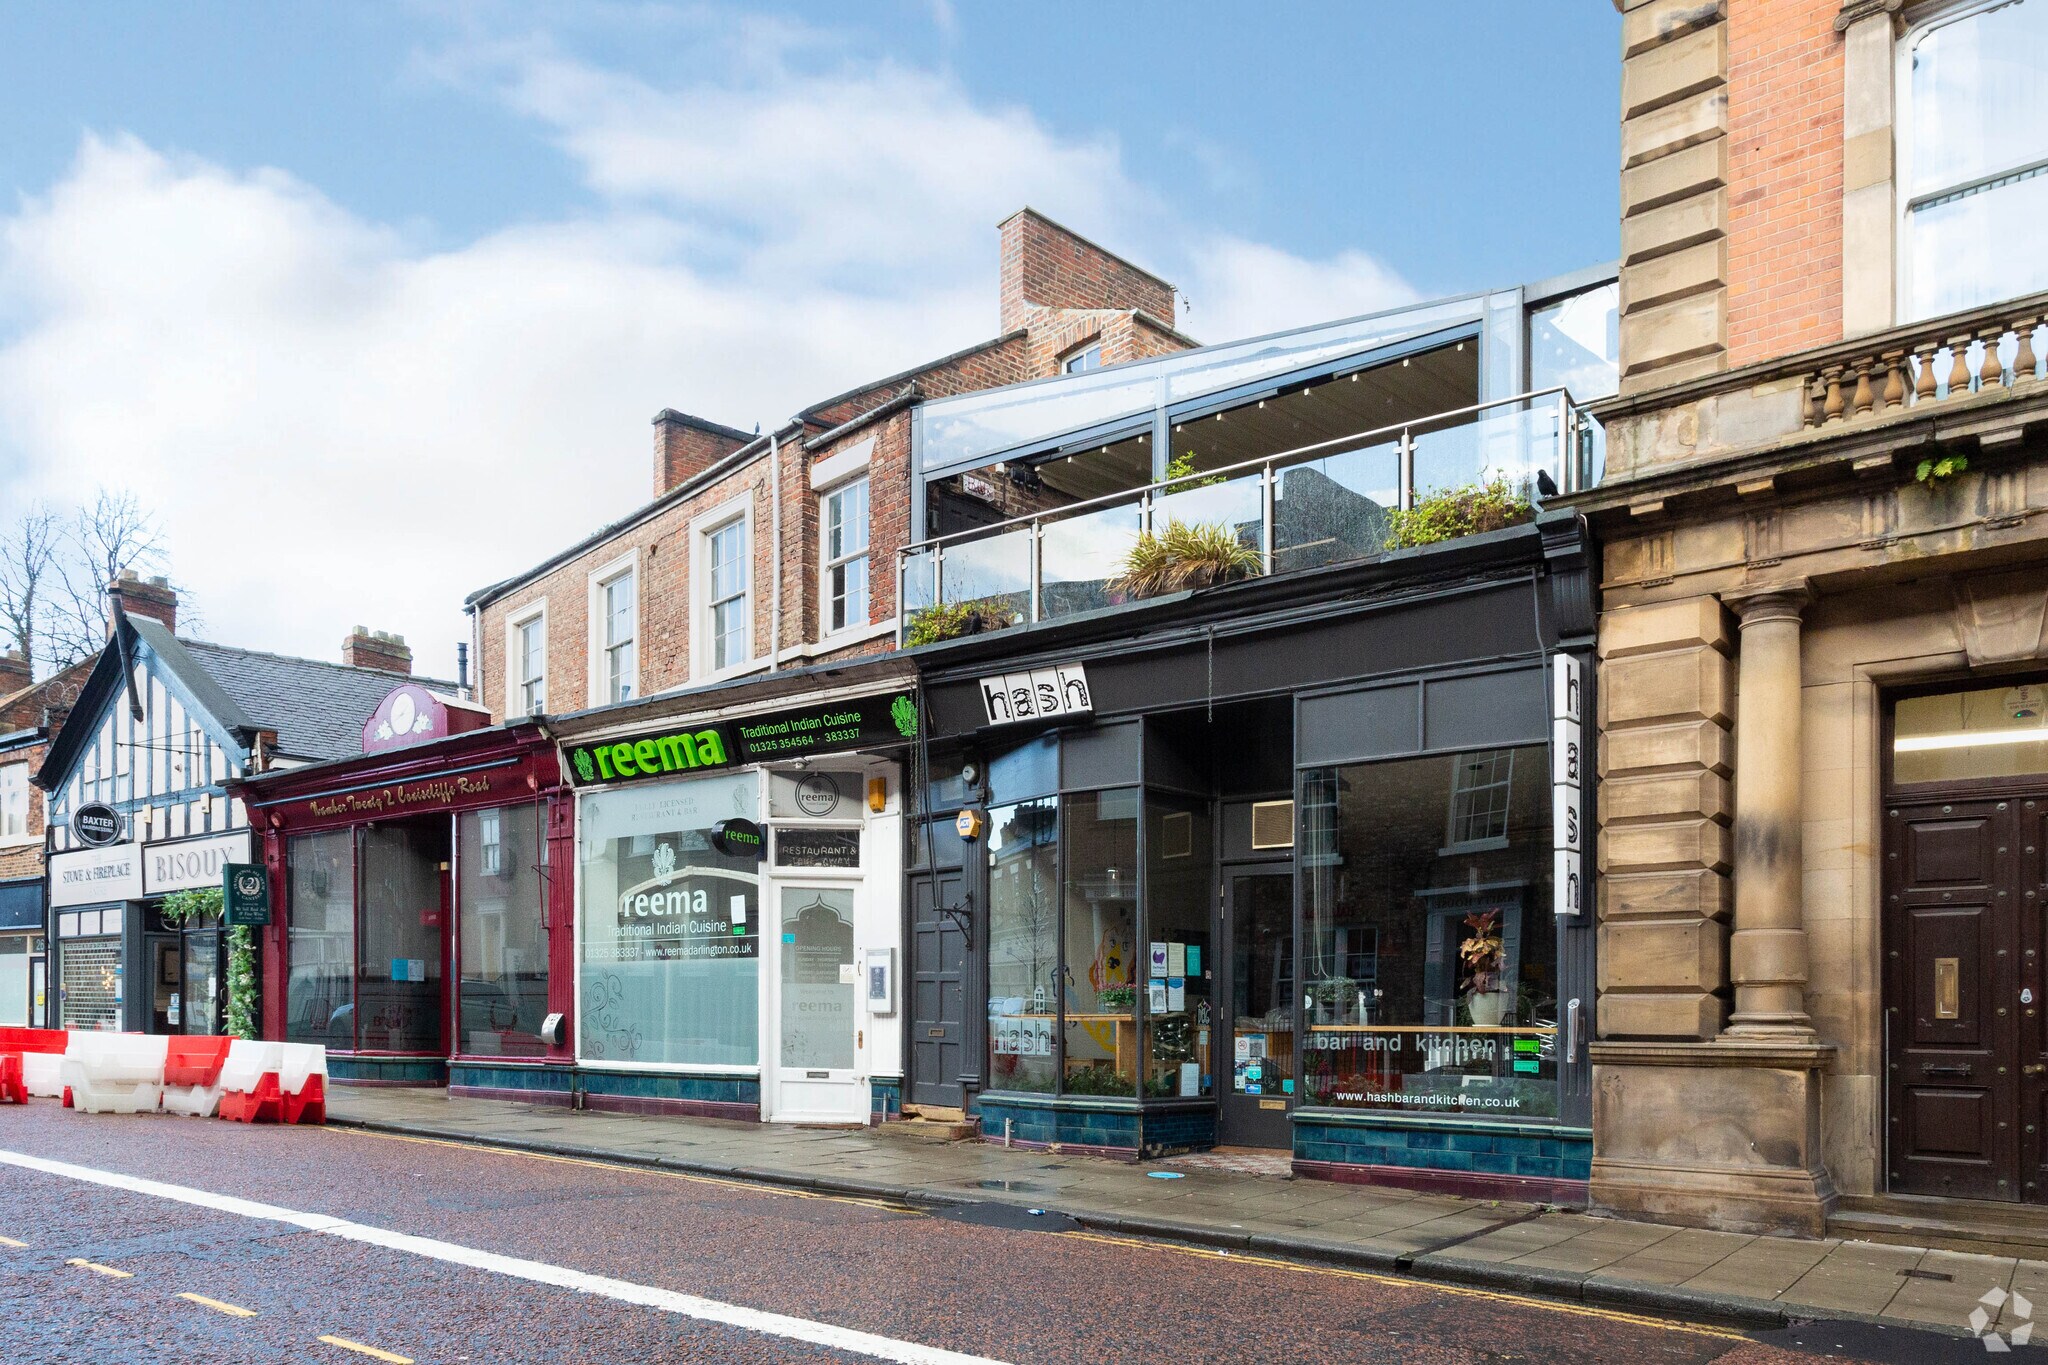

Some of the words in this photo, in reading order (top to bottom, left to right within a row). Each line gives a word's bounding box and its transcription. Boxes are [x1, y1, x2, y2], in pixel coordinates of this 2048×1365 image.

[984, 672, 1089, 720] hash
[740, 721, 789, 739] Traditional
[790, 718, 822, 731] Indian
[823, 712, 861, 727] Cuisine
[749, 741, 777, 753] 01325
[778, 735, 814, 749] 354564
[824, 728, 860, 742] 383337
[593, 729, 728, 780] reema
[310, 799, 348, 816] Number
[346, 795, 382, 811] Twenty
[383, 789, 395, 806] 2
[457, 775, 490, 794] Road
[1566, 664, 1579, 909] hash
[82, 815, 114, 827] BAXTER
[725, 830, 760, 844] reema
[783, 847, 847, 855] RESTAURANT
[850, 847, 857, 855] &
[63, 869, 84, 883] STOVE
[86, 868, 92, 881] &
[93, 863, 131, 880] FIREPLACE
[245, 877, 255, 889] 2
[623, 889, 708, 917] reema
[608, 925, 654, 938] Traditional
[657, 922, 687, 935] Indian
[689, 919, 727, 933] Cuisine
[36, 939, 45, 951] 26
[610, 947, 640, 958] 383337
[645, 943, 752, 957] www.reemadarlington.co.uk
[792, 1001, 842, 1012] reema
[1317, 1032, 1350, 1050] bar
[1363, 1034, 1401, 1051] and
[1415, 1034, 1497, 1053] kitchen
[1336, 1092, 1520, 1108] www.hashbarandkitchen.co.uk
